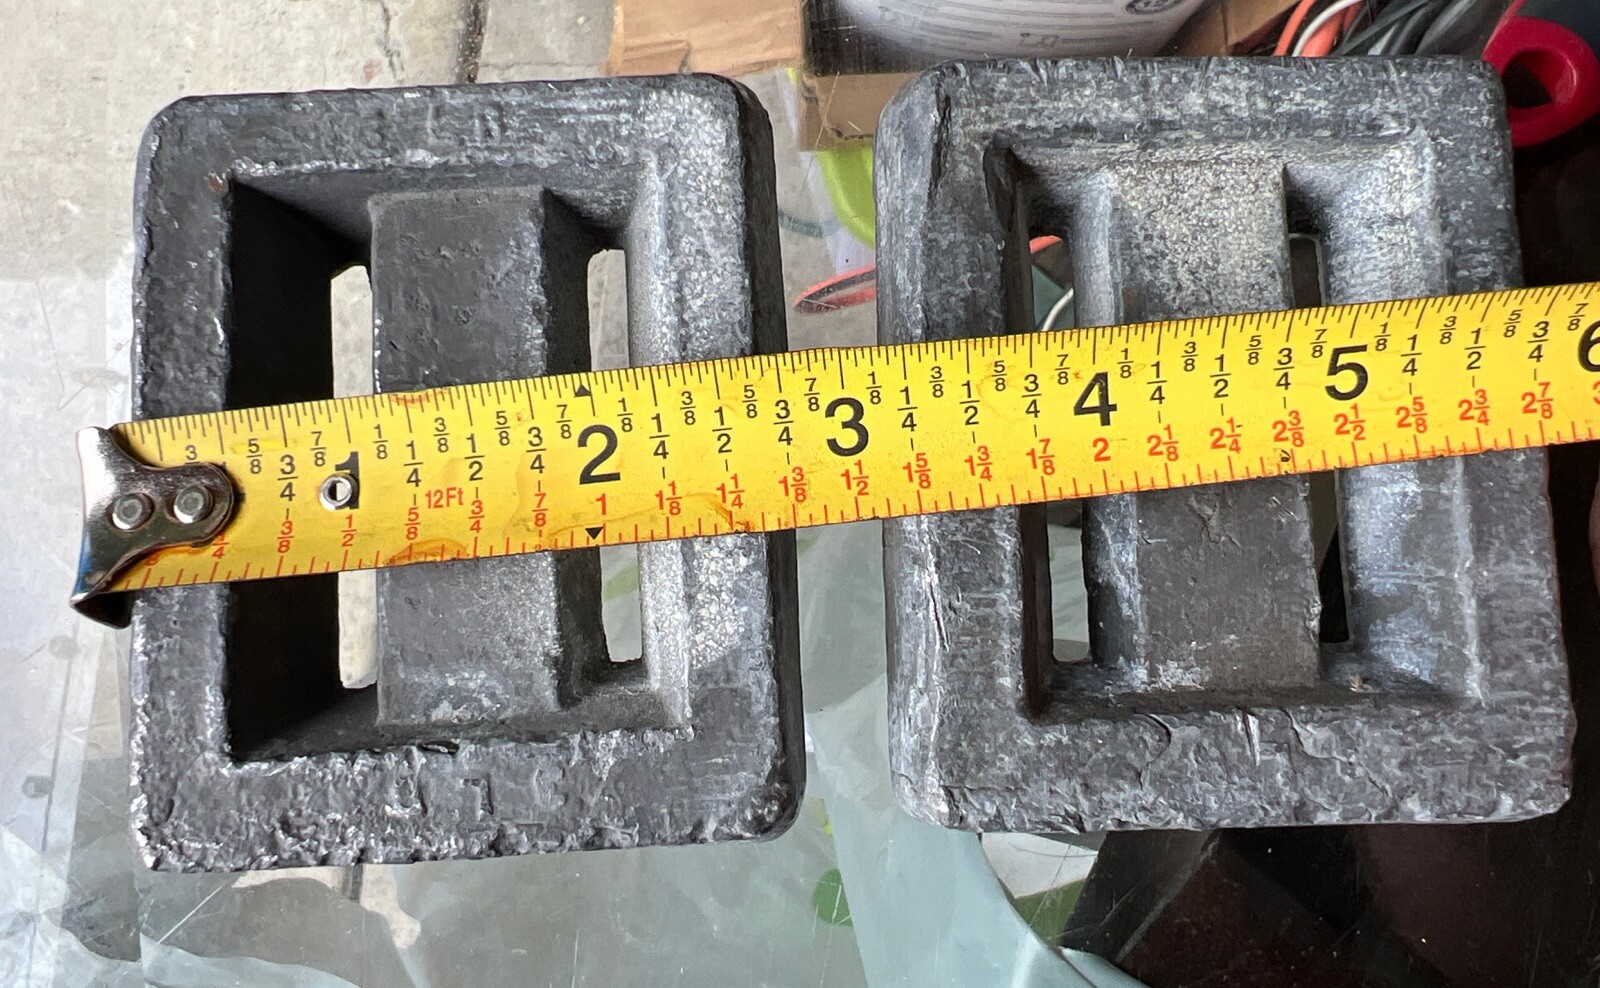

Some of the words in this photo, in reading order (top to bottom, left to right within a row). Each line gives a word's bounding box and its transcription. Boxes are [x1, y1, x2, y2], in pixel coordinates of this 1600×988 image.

[335, 451, 360, 510] 1
[577, 424, 621, 485] 2
[825, 397, 870, 457] 3
[1073, 371, 1118, 427] 4
[1325, 344, 1369, 401] 5
[425, 487, 464, 509] 12Ft
[596, 494, 607, 515] 1
[1092, 437, 1110, 462] 2
